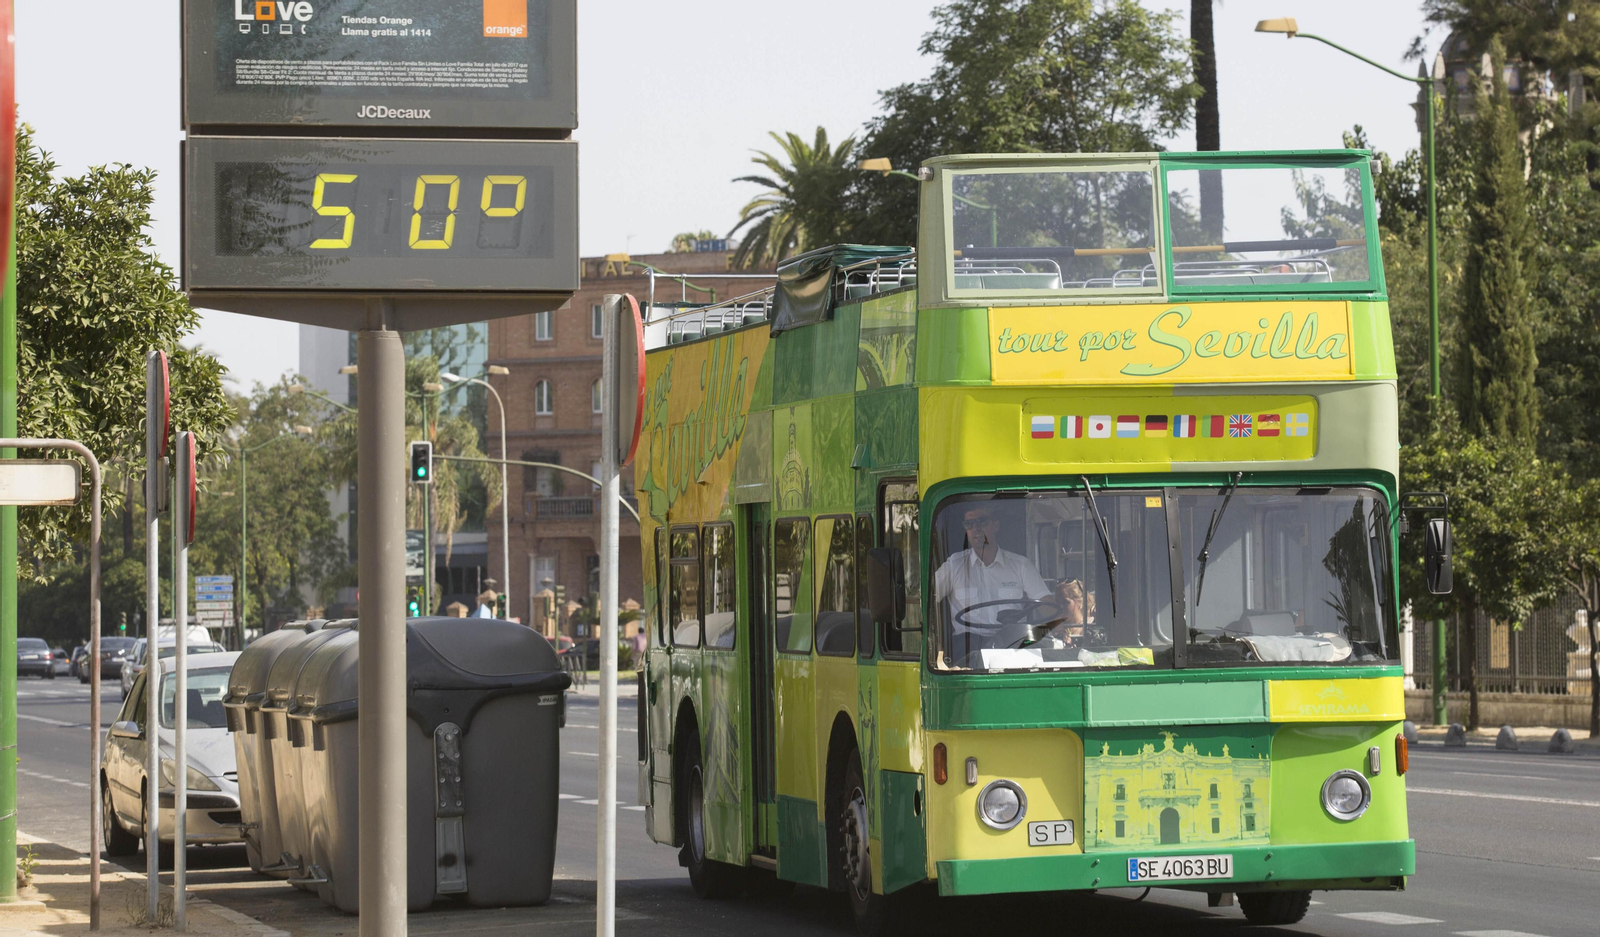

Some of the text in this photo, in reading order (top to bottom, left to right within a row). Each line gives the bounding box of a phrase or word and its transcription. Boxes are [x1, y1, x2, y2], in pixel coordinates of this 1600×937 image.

[235, 0, 313, 22] Love
[341, 16, 413, 26] Tiendas Orange
[341, 28, 369, 36] Llama
[371, 28, 397, 37] gratis
[410, 29, 431, 37] 1414
[356, 105, 431, 119] JCDecaux
[998, 305, 1348, 377] tour por Sevilla
[1298, 702, 1370, 717] SEVIRAMA
[1034, 824, 1068, 843] SP
[1138, 860, 1159, 878] SE
[1162, 859, 1205, 876] 4063
[1207, 858, 1230, 875] BU
